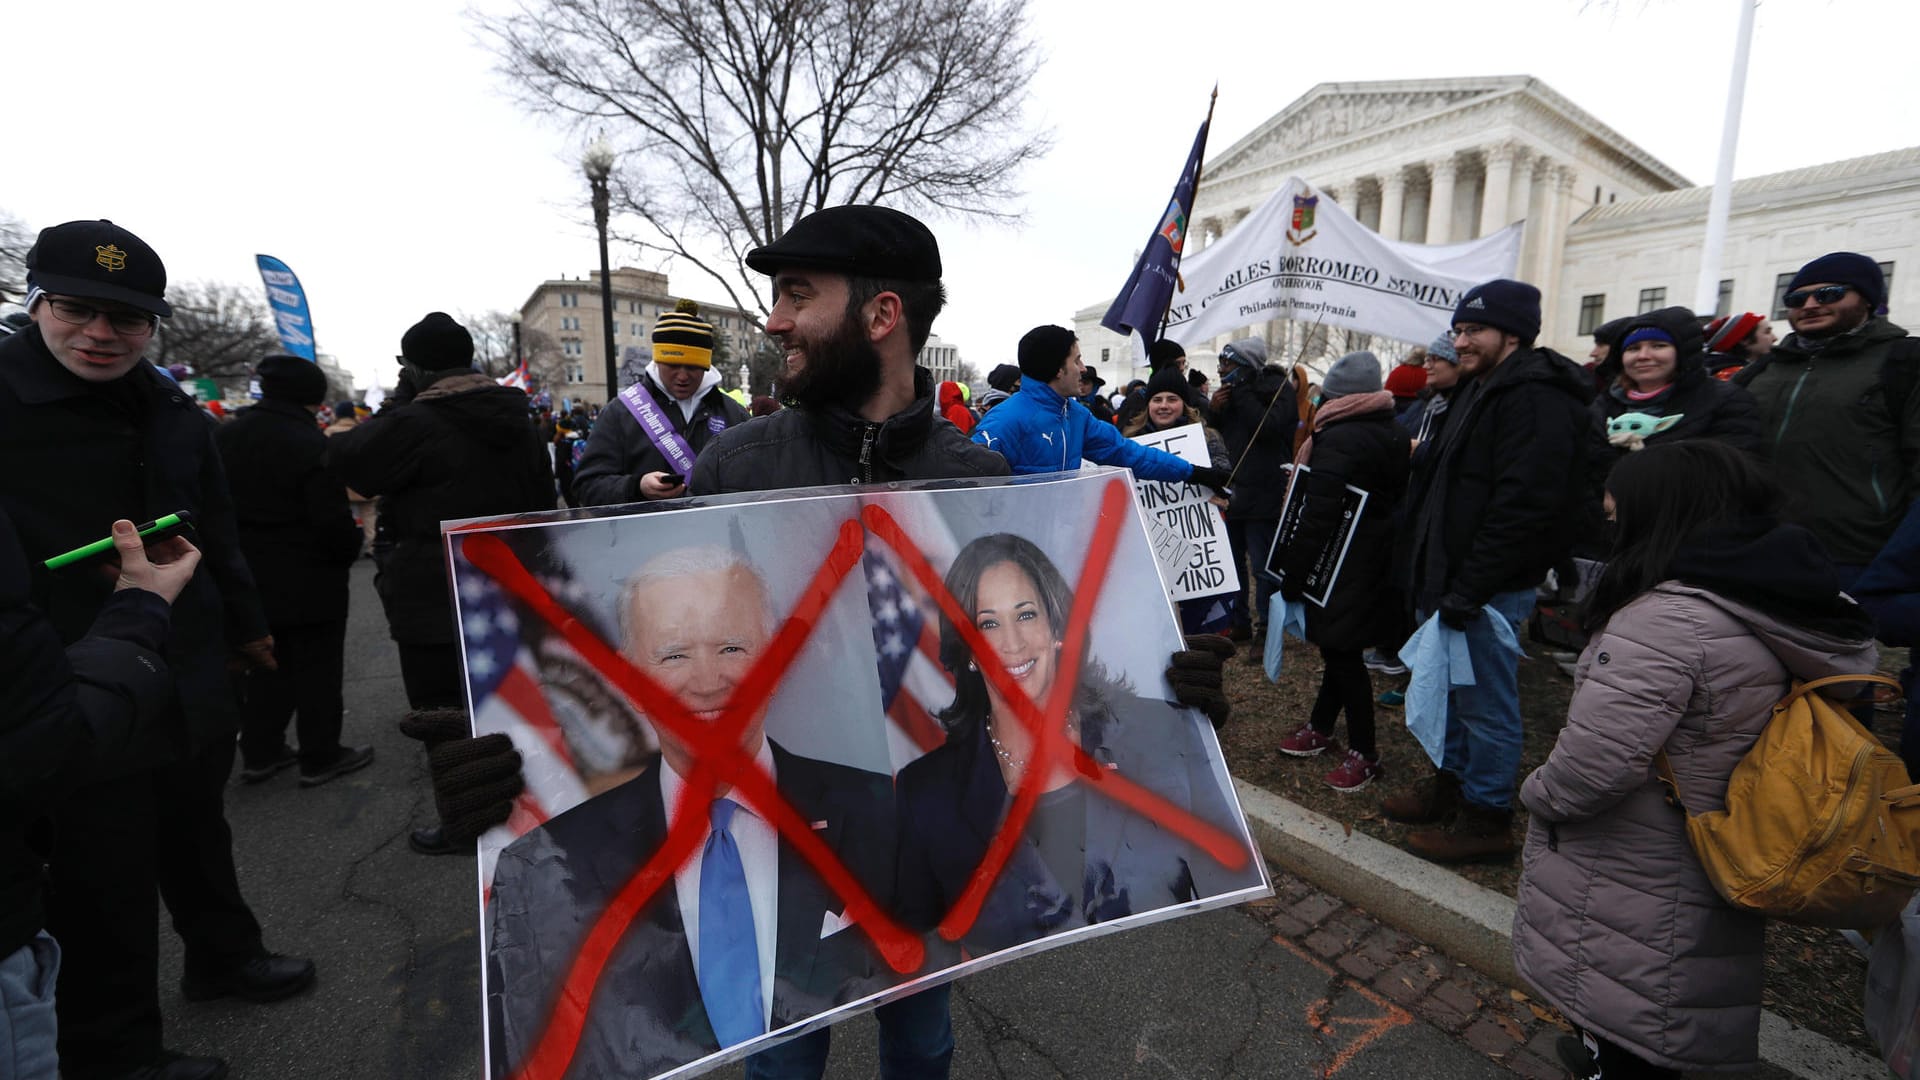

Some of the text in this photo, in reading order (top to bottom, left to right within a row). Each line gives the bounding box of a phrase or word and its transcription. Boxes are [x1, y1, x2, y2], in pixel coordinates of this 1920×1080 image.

[1279, 256, 1379, 286] BORROMEO
[1289, 297, 1357, 318] Pennsylvania
[637, 402, 666, 436] Preborn
[659, 430, 684, 460] Women
